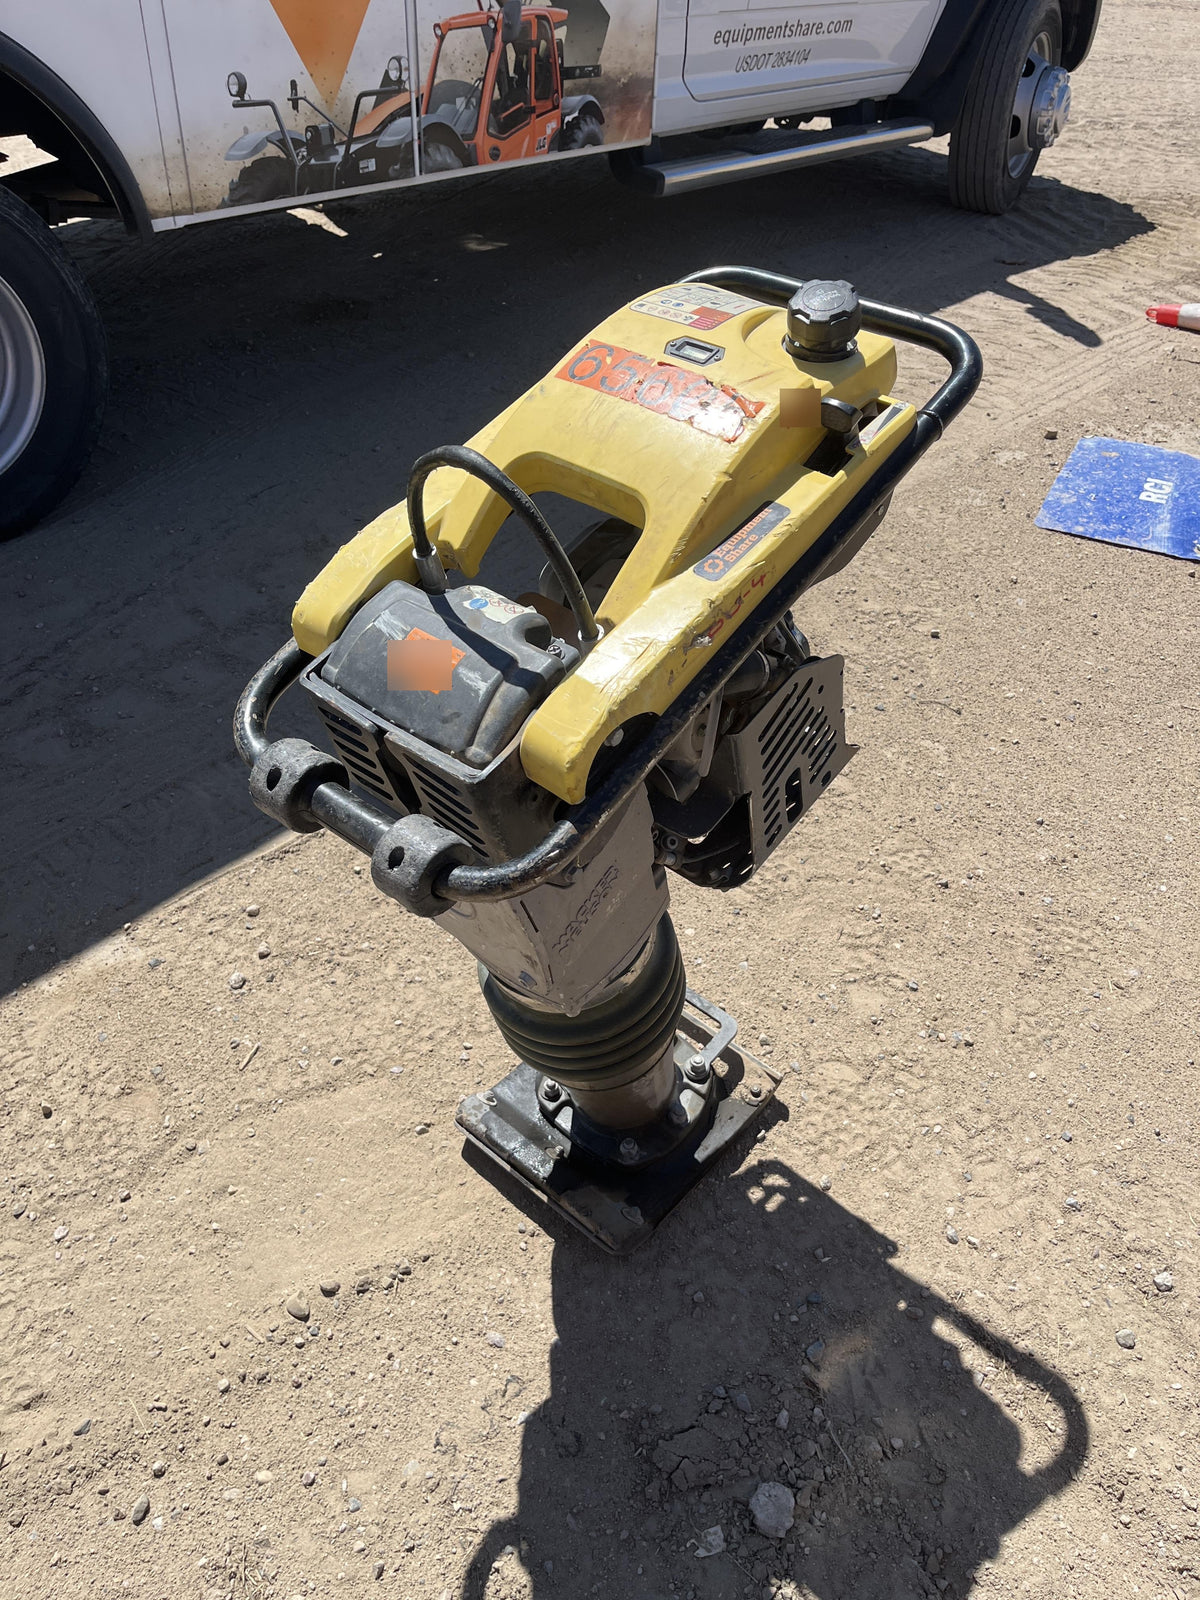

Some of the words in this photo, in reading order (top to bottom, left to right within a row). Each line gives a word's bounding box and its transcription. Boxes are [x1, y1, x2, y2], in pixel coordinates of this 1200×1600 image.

[713, 19, 853, 47] equipmentshare.com
[735, 52, 774, 73] USDOT
[771, 48, 812, 68] 2834104
[1138, 477, 1174, 505] RCI
[713, 507, 773, 558] Equipment
[724, 534, 759, 563] Share
